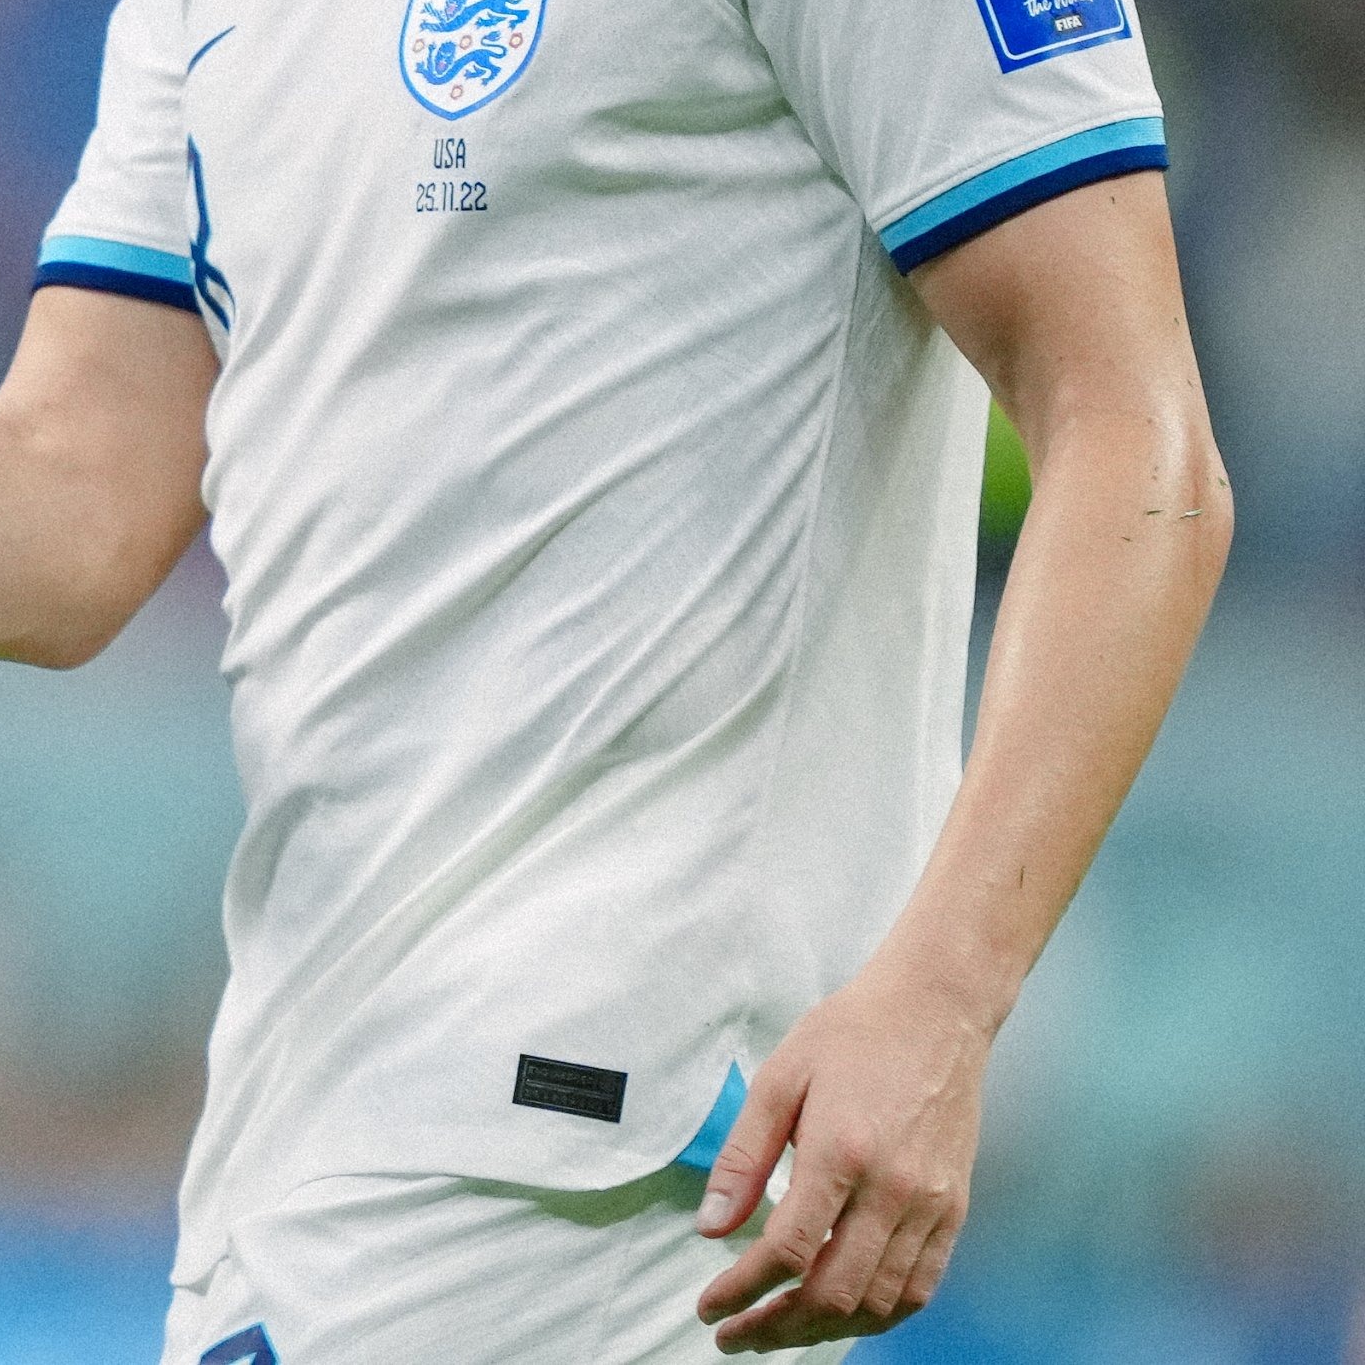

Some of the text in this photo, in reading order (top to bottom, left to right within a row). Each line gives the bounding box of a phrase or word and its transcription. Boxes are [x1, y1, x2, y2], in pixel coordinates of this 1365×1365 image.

[1054, 14, 1084, 32] FIFA
[433, 138, 466, 169] USA
[415, 181, 489, 213] 25.11.22
